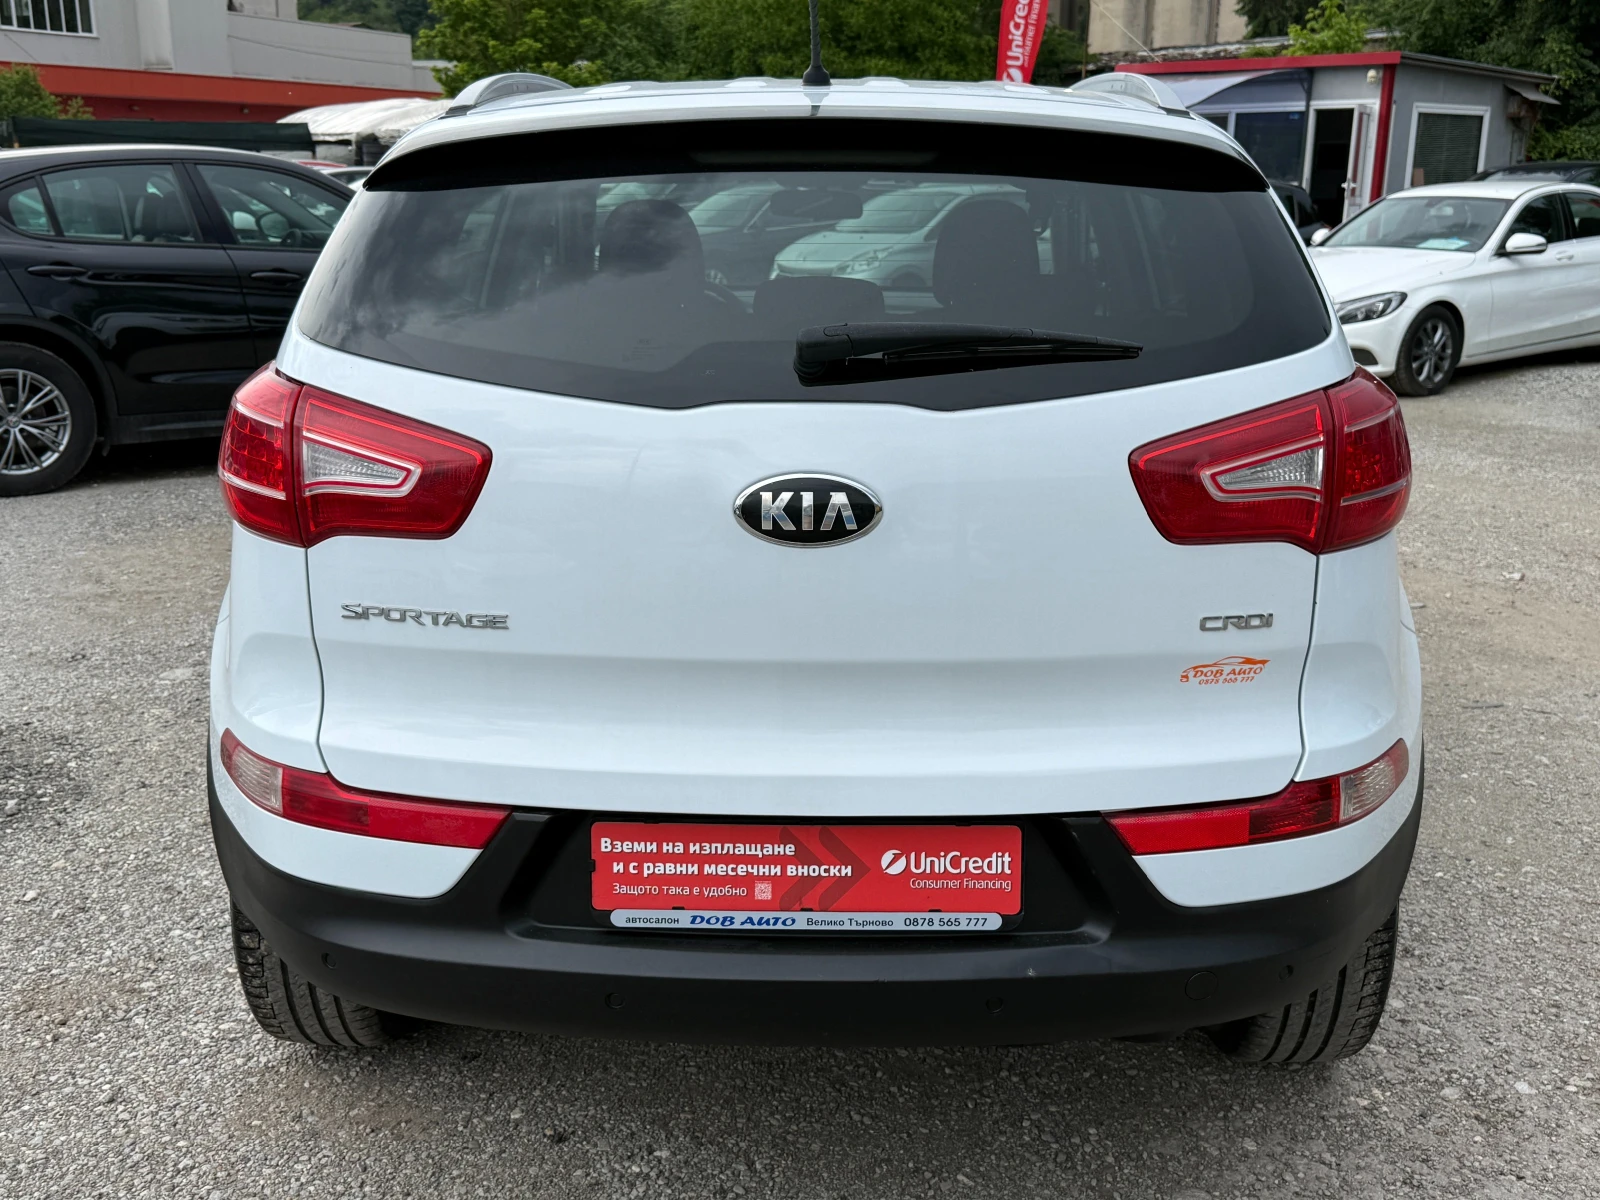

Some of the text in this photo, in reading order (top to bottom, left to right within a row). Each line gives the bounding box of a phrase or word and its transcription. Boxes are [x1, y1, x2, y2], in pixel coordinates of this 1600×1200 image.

[759, 491, 858, 531] KIA
[341, 603, 510, 630] SPORTAGE
[1199, 613, 1274, 632] CRDI
[1193, 667, 1262, 678] DOB AUTO
[600, 837, 796, 858] Вземи на изплащане
[612, 861, 852, 878] и с равни месечни вноски
[910, 851, 1012, 874] UniCredit
[612, 882, 748, 897] Защото така е удобно
[909, 877, 1012, 892] Consumer Financing
[625, 916, 680, 925] автосалон
[689, 915, 797, 927] DOB AUTO
[806, 917, 894, 929] Велико Търново
[904, 917, 988, 927] 0878 565 777
